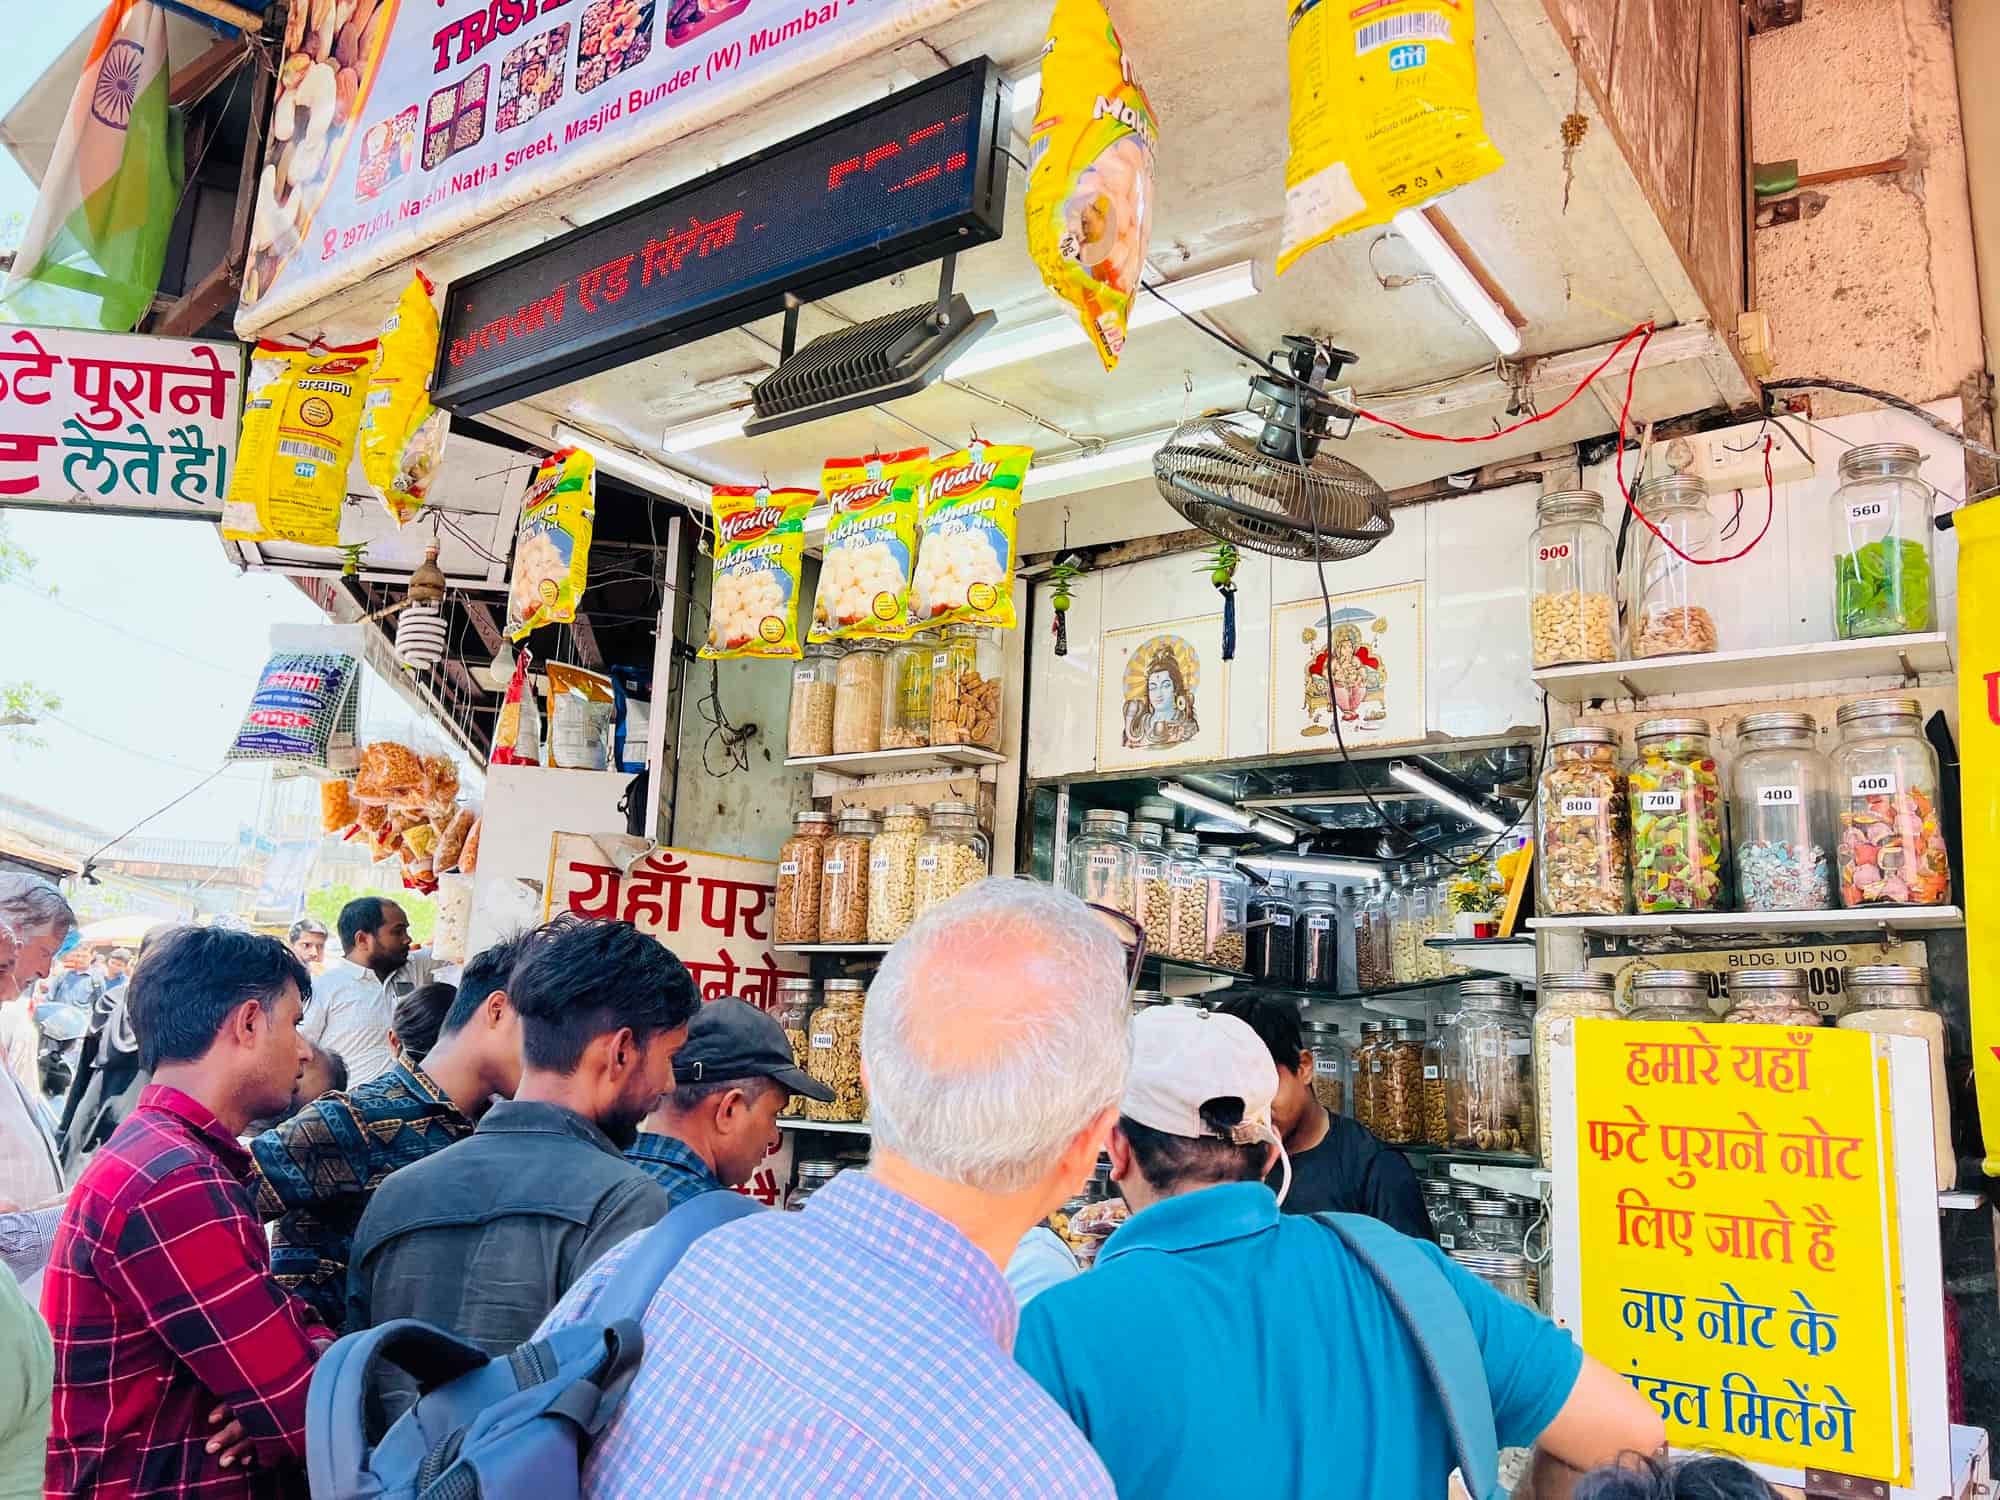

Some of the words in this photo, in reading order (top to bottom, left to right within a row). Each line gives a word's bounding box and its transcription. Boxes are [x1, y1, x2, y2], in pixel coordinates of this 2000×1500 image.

[564, 97, 621, 144] Masjid
[628, 65, 701, 115] Bunder
[706, 43, 742, 80] (W)
[749, 3, 839, 57] Mumbai
[0, 330, 62, 405] टे
[68, 345, 235, 431] पुराने
[62, 419, 165, 495] लेते
[1852, 503, 1881, 517] 560
[1539, 544, 1569, 560] 900
[1566, 800, 1592, 812] 800
[1648, 794, 1674, 807] 700
[1764, 789, 1792, 801] 400
[1858, 777, 1888, 790] 400
[568, 853, 691, 931] यहाँ
[698, 877, 776, 940] पर
[1728, 952, 1780, 967] BLDG.
[1785, 951, 1815, 964] UID
[1624, 1026, 1720, 1087] हमारे
[1733, 1031, 1813, 1092] यहाँ
[1588, 1105, 1649, 1163] फटे
[1660, 1112, 1768, 1189] पुराने
[1777, 1116, 1865, 1182] नोट
[1616, 1189, 1694, 1258] लिए
[1705, 1200, 1794, 1265] जाते
[1804, 1204, 1838, 1272] है
[1621, 1288, 1685, 1343] नए
[1695, 1282, 1777, 1349] नोट
[1788, 1290, 1839, 1357] के
[1619, 1358, 1711, 1429] ंडल
[1720, 1372, 1857, 1454] मिलेंगे
